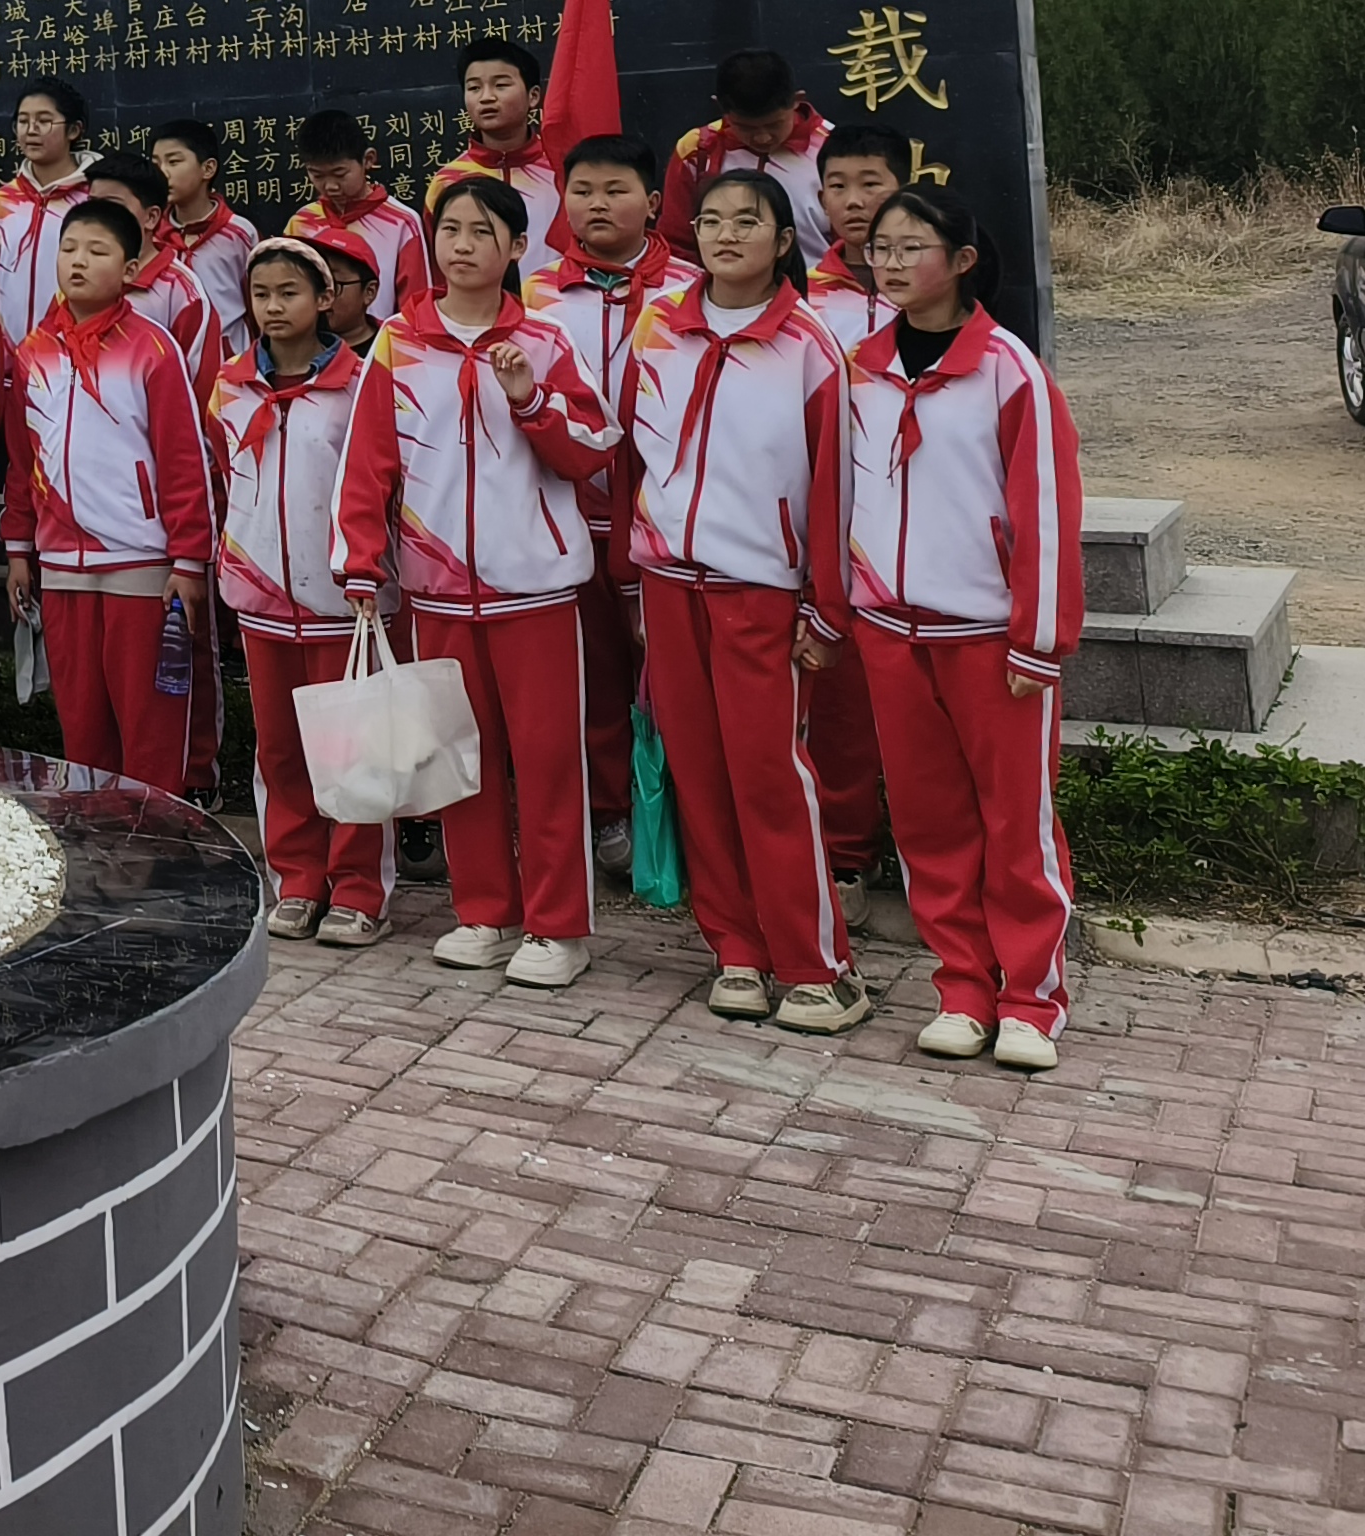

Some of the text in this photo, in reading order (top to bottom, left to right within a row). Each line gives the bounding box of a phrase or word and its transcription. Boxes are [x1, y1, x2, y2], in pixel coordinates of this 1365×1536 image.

[217, 117, 252, 206] 周全明
[249, 115, 284, 205] 贺方明
[381, 110, 419, 201] 刘同意
